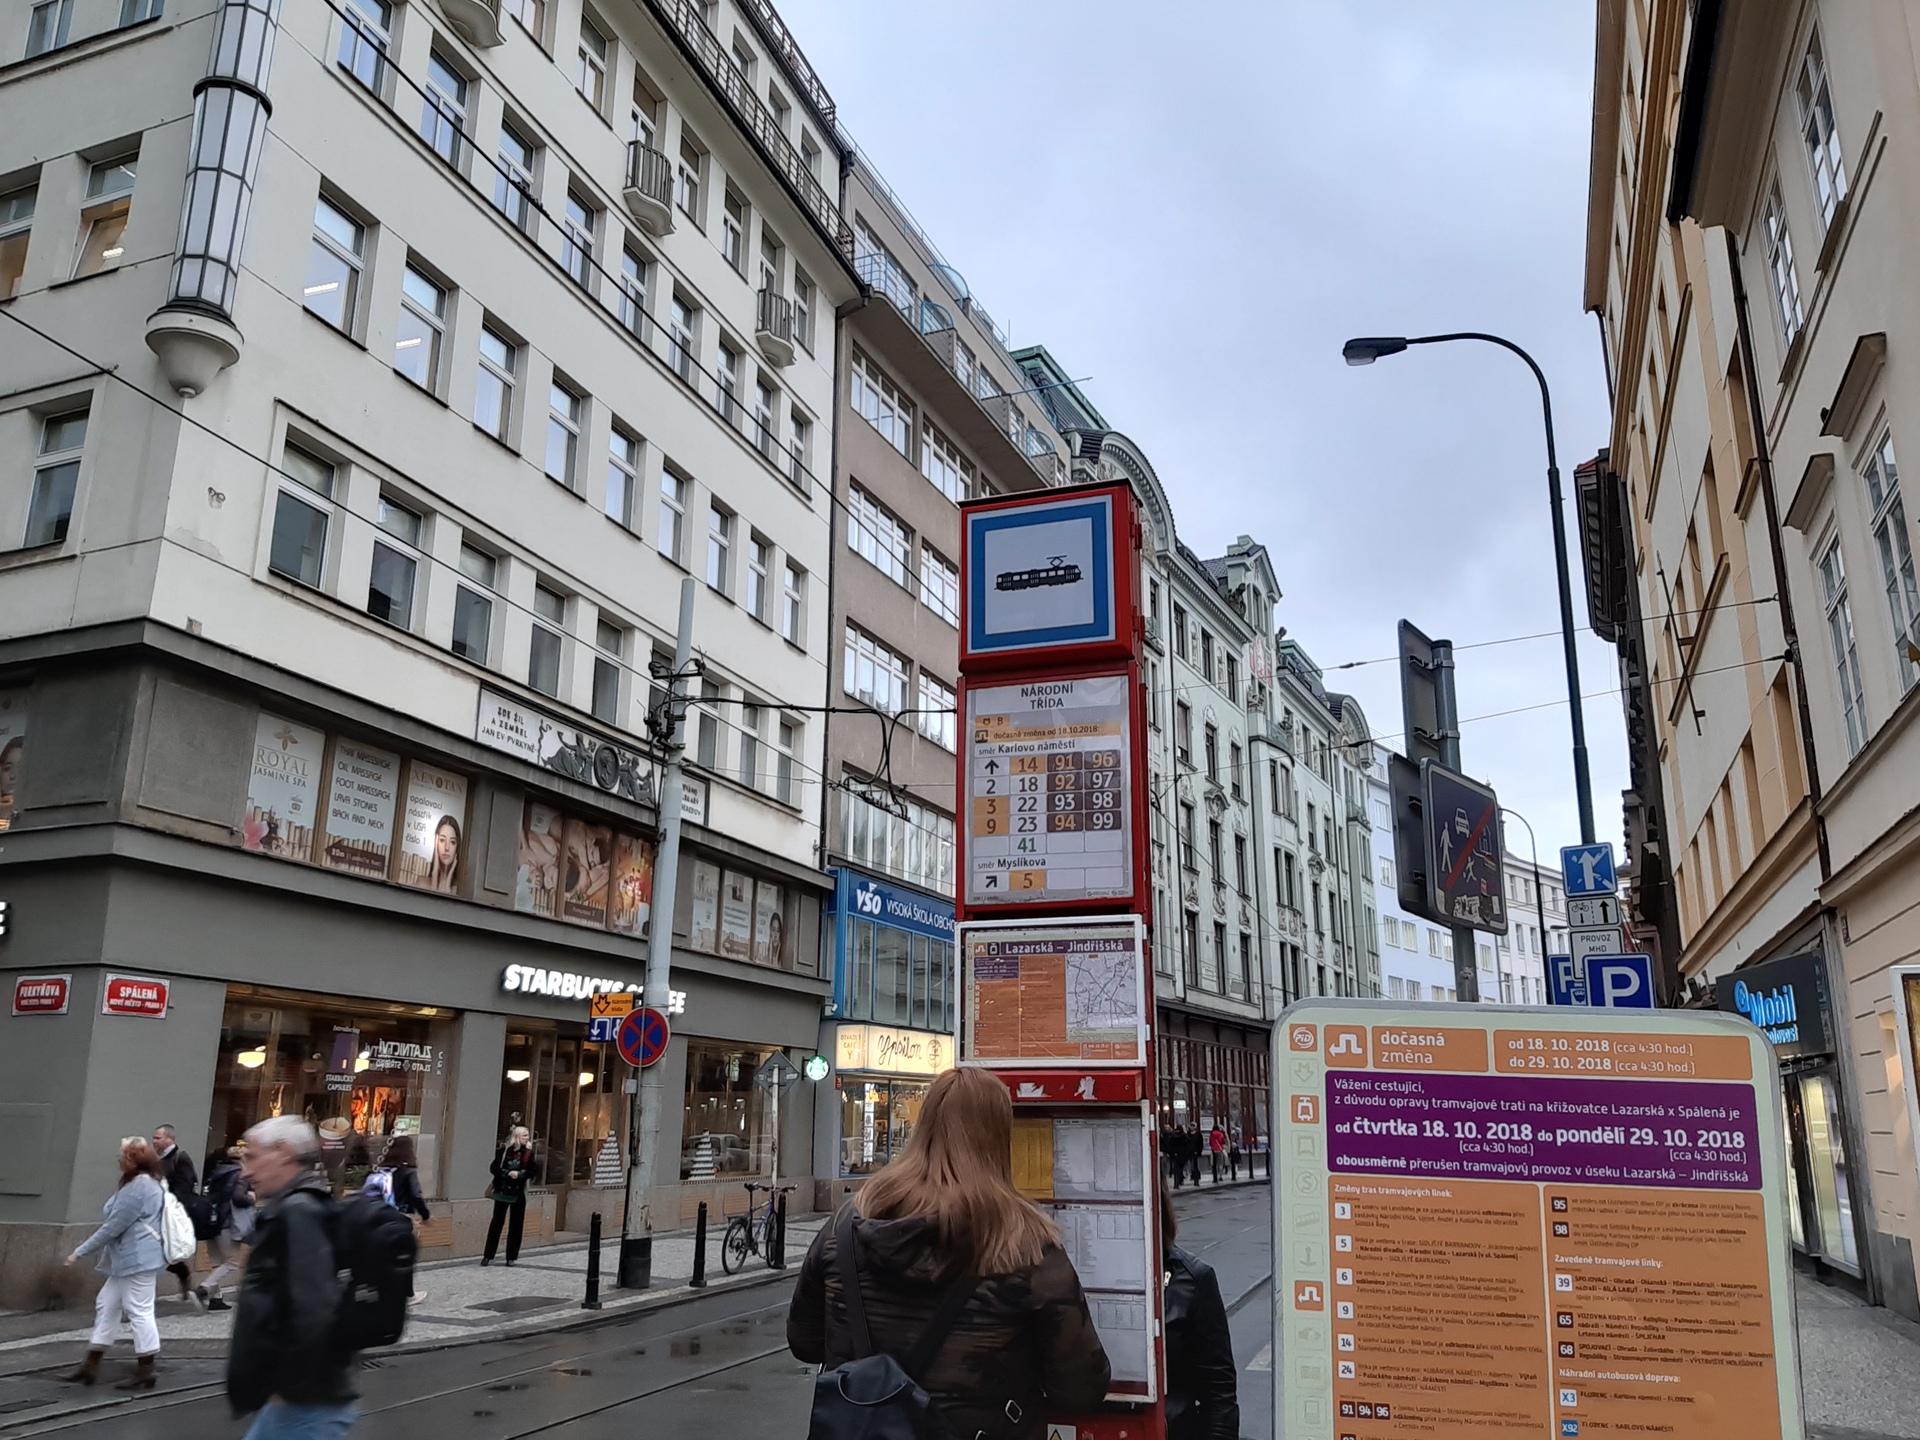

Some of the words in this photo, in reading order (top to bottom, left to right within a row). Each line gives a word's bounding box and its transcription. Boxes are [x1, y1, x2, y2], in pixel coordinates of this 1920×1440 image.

[1021, 682, 1074, 698] NÁRODNÍ
[1030, 698, 1064, 710] TŘÍDA
[482, 726, 496, 736] JAN
[994, 730, 1022, 739] dočasná
[1048, 727, 1056, 736] od
[1058, 726, 1100, 736] 18.10.2018:
[979, 748, 996, 756] směr
[998, 743, 1035, 754] Karlovo
[1038, 740, 1076, 752] náměstí
[257, 748, 308, 776] ROYAL
[338, 762, 348, 772] OIL
[1018, 757, 1038, 772] 14
[1055, 754, 1075, 770] 91
[1092, 752, 1113, 768] 96
[254, 766, 290, 783] JASMINE
[292, 777, 306, 788] SPA
[336, 777, 354, 789] FOOT
[412, 770, 462, 794] XENOTAN
[986, 780, 996, 794] 2
[1019, 776, 1038, 792] 18
[1056, 774, 1076, 790] 92
[1092, 772, 1113, 788] 97
[334, 792, 350, 804] LAVA
[353, 798, 378, 812] STONES
[410, 796, 443, 810] opalovací
[987, 799, 996, 814] 3
[1018, 797, 1038, 812] 22
[1055, 794, 1076, 810] 93
[1092, 792, 1113, 809] 98
[332, 808, 349, 820] BACK
[352, 814, 365, 824] AND
[368, 819, 384, 830] NECK
[414, 821, 426, 831] USA
[986, 818, 996, 834] 9
[1018, 817, 1038, 833] 23
[1055, 814, 1076, 830] 94
[1092, 812, 1114, 829] 99
[1018, 837, 1036, 852] 41
[978, 862, 995, 870] směr
[997, 857, 1046, 868] Myslíkova
[1024, 873, 1032, 888] 5
[856, 882, 882, 914] VŠO
[886, 898, 912, 919] VYSOKÁ
[914, 905, 933, 926] ŠKOLA
[1581, 934, 1611, 942] PROVOZ
[1006, 940, 1053, 954] Lazarská
[1068, 938, 1124, 952] Jindřišská
[120, 985, 158, 1000] SPÁLENÁ
[1602, 966, 1640, 1006] P
[1381, 1031, 1445, 1047] dočasná
[878, 1034, 922, 1065] Ypsilon
[1508, 1039, 1523, 1049] od
[1528, 1039, 1547, 1050] 18.
[1551, 1039, 1572, 1051] 10.
[1576, 1040, 1609, 1052] 2018
[1613, 1041, 1636, 1054] (cca
[1638, 1042, 1662, 1053] 4:30
[1665, 1043, 1693, 1056] hod.)
[1382, 1050, 1433, 1064] změna
[1510, 1057, 1525, 1068] do
[1528, 1057, 1548, 1068] 29.
[1552, 1058, 1574, 1069] 10.
[1577, 1058, 1611, 1070] 2018
[1615, 1060, 1638, 1072] (cca
[1640, 1061, 1664, 1072] 4:30
[1667, 1062, 1695, 1074] hod.)
[1334, 1078, 1372, 1090] Vážení
[1374, 1080, 1425, 1094] cestující,
[1344, 1094, 1386, 1106] důvodu
[1389, 1098, 1429, 1110] opravy
[1432, 1098, 1498, 1112] tramvajové
[1501, 1100, 1526, 1112] trati
[1529, 1103, 1543, 1112] na
[1547, 1101, 1608, 1114] křižovatce
[1611, 1104, 1664, 1117] Lazarská
[1668, 1108, 1675, 1116] x
[1678, 1105, 1726, 1119] Spálená
[1728, 1108, 1740, 1120] je
[1336, 1122, 1350, 1134] od
[1353, 1116, 1418, 1136] čtvrtka
[1422, 1120, 1449, 1138] 18.
[1454, 1122, 1482, 1139] 10.
[1486, 1122, 1532, 1142] 2018
[1538, 1131, 1553, 1142] do
[1556, 1126, 1625, 1146] pondělí
[1630, 1128, 1658, 1146] 29.
[1664, 1129, 1693, 1147] 10.
[1698, 1130, 1746, 1149] 2018
[1460, 1141, 1480, 1154] (cca
[1483, 1142, 1505, 1153] 4:30
[1508, 1143, 1534, 1156] hod.)
[1670, 1149, 1692, 1162] (cca
[1694, 1150, 1717, 1162] 4:30
[1720, 1151, 1747, 1165] hod.)
[1336, 1155, 1407, 1168] obousměrně
[1410, 1158, 1460, 1172] přerušen
[1463, 1160, 1528, 1176] tramvajový
[1532, 1164, 1571, 1178] provoz
[1575, 1166, 1582, 1176] v
[1585, 1165, 1620, 1177] úseku
[1624, 1166, 1676, 1180] Lazarská
[1690, 1169, 1748, 1183] Jindřišská
[1334, 1184, 1360, 1195] Změny
[1379, 1187, 1430, 1198] tramvajových
[1432, 1188, 1452, 1198] linek:
[1340, 1206, 1346, 1216] 3
[1554, 1200, 1566, 1210] 95
[1555, 1225, 1568, 1235] 98
[1340, 1238, 1347, 1248] 5
[1554, 1254, 1593, 1264] Zavedené
[1595, 1258, 1639, 1268] tramvajové
[1641, 1258, 1664, 1268] linky:
[1342, 1272, 1348, 1280] 6
[1558, 1278, 1570, 1288] 39
[1342, 1306, 1349, 1314] 9
[1559, 1315, 1572, 1325] 65
[1341, 1338, 1352, 1347] 14
[1560, 1345, 1573, 1355] 68
[1341, 1364, 1352, 1374] 24
[1559, 1369, 1596, 1379] Náhradní
[1598, 1371, 1644, 1381] autobusová
[1646, 1373, 1681, 1383] doprava:
[1562, 1393, 1576, 1402] X3
[1342, 1404, 1354, 1414] 91
[1359, 1405, 1371, 1416] 94
[1376, 1406, 1388, 1416] 96
[1562, 1424, 1578, 1433] X92
